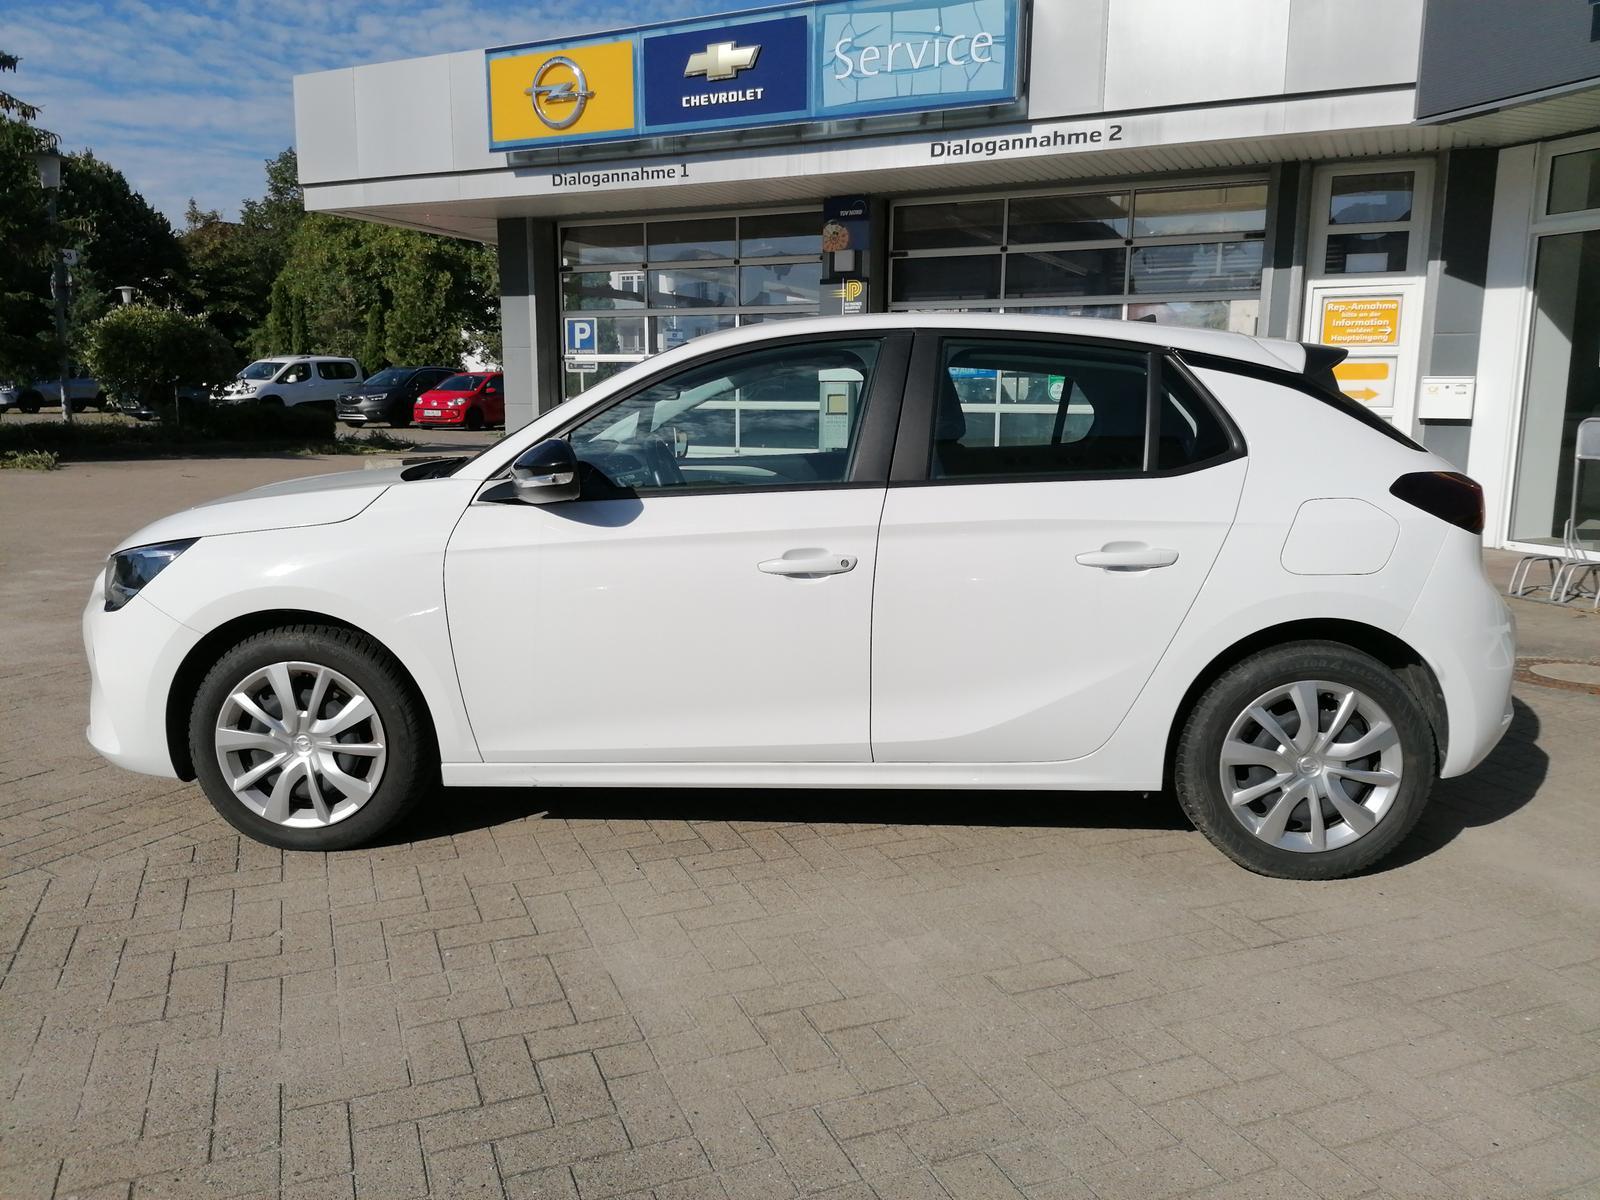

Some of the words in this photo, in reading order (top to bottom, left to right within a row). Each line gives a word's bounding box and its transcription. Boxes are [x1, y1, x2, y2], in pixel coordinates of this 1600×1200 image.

[835, 25, 993, 80] Service
[682, 88, 764, 108] CHEVROLET
[930, 130, 1102, 158] Dialogannahme
[1108, 125, 1123, 142] 2
[552, 167, 676, 187] Dialogannahme
[680, 163, 690, 178] 1
[1327, 302, 1398, 313] Rep.-Annahme
[1332, 318, 1390, 328] Information
[574, 322, 591, 349] P
[1331, 334, 1389, 343] Haupteingang
